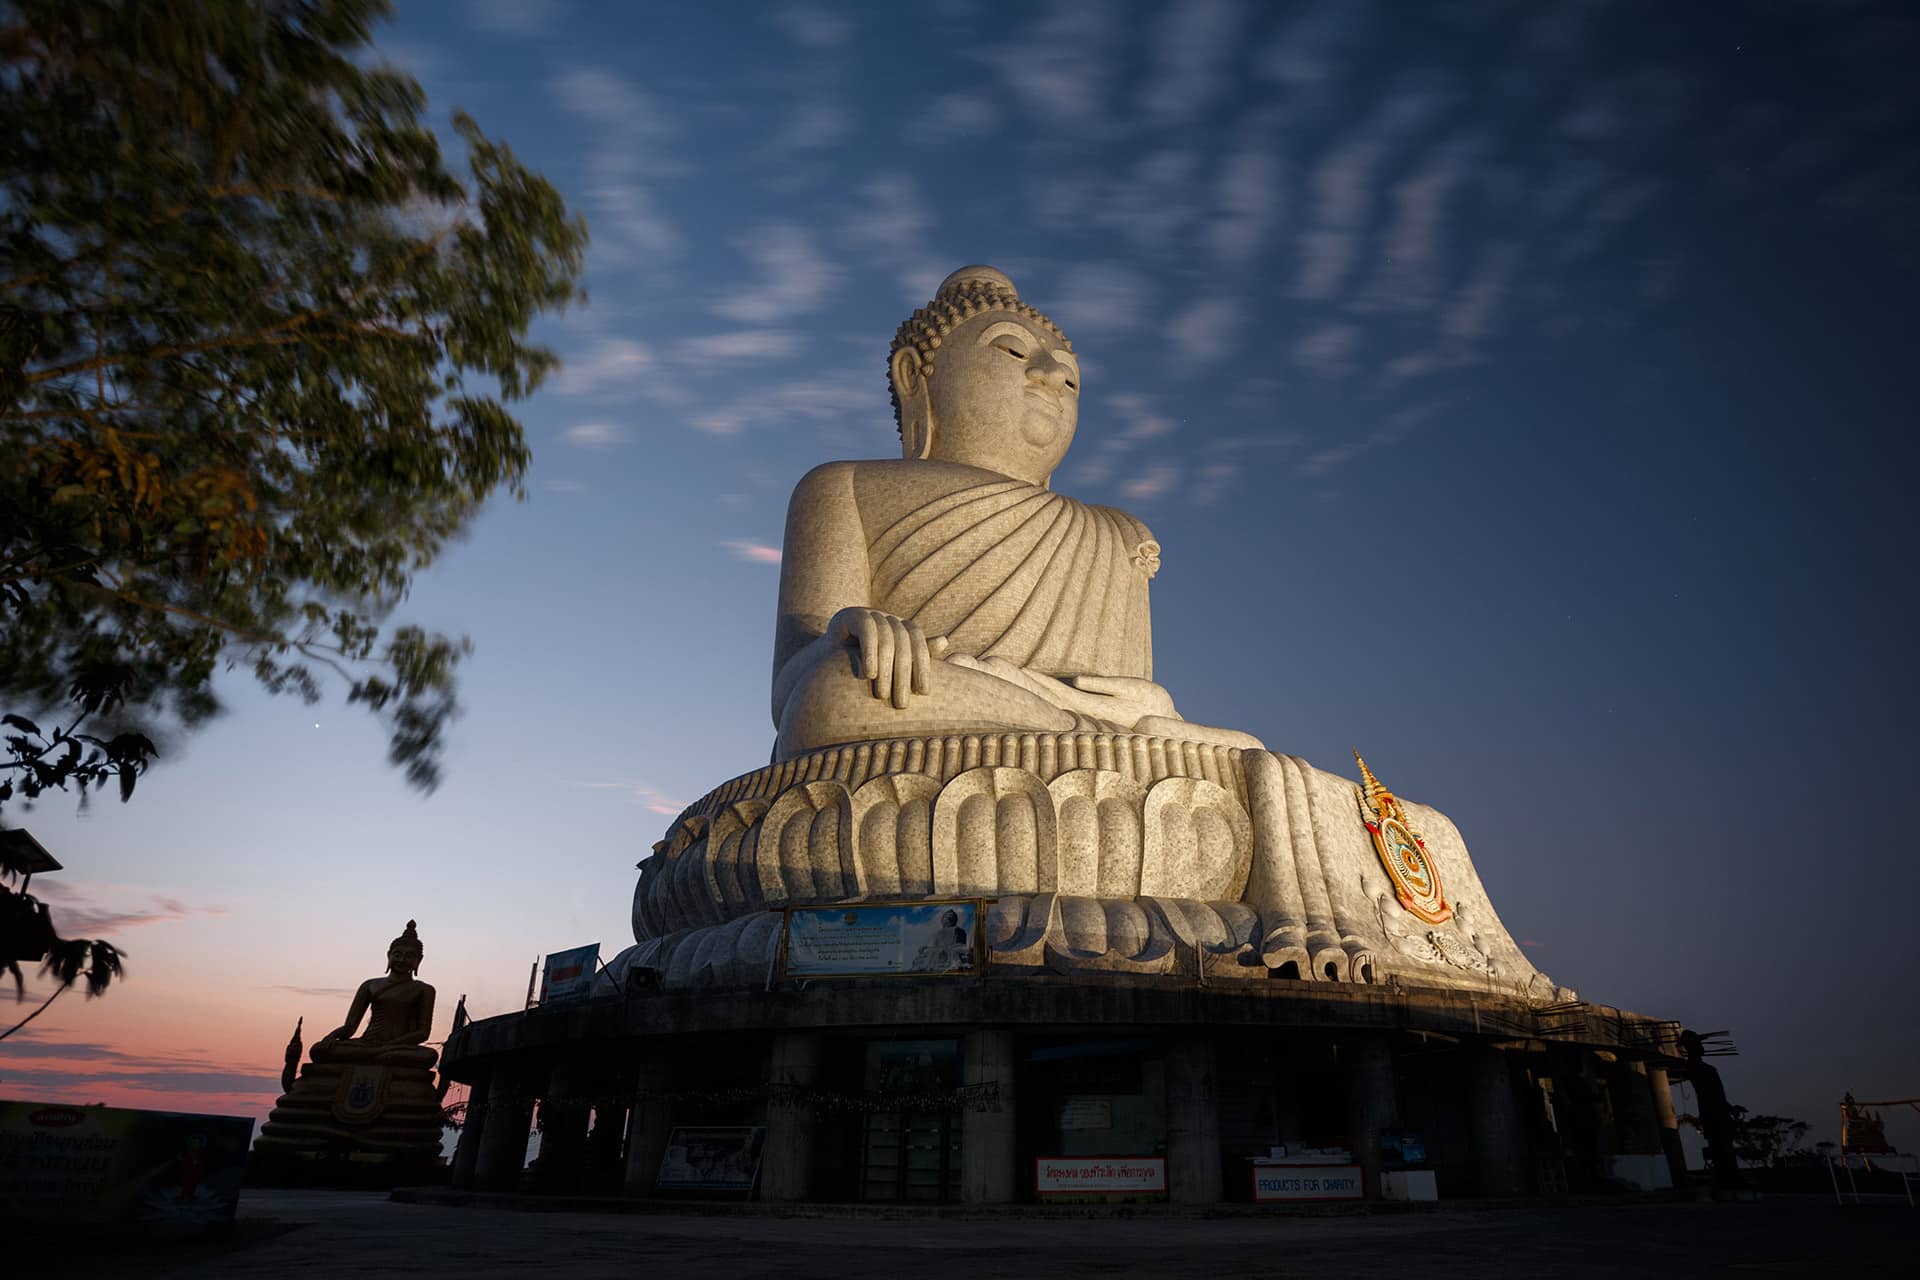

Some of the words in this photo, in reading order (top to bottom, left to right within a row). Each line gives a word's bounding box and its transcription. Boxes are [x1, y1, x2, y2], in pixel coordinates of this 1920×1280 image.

[1259, 1178, 1301, 1191] PRODUCTS
[1303, 1178, 1320, 1191] FOR
[1323, 1178, 1354, 1191] CHARITY
